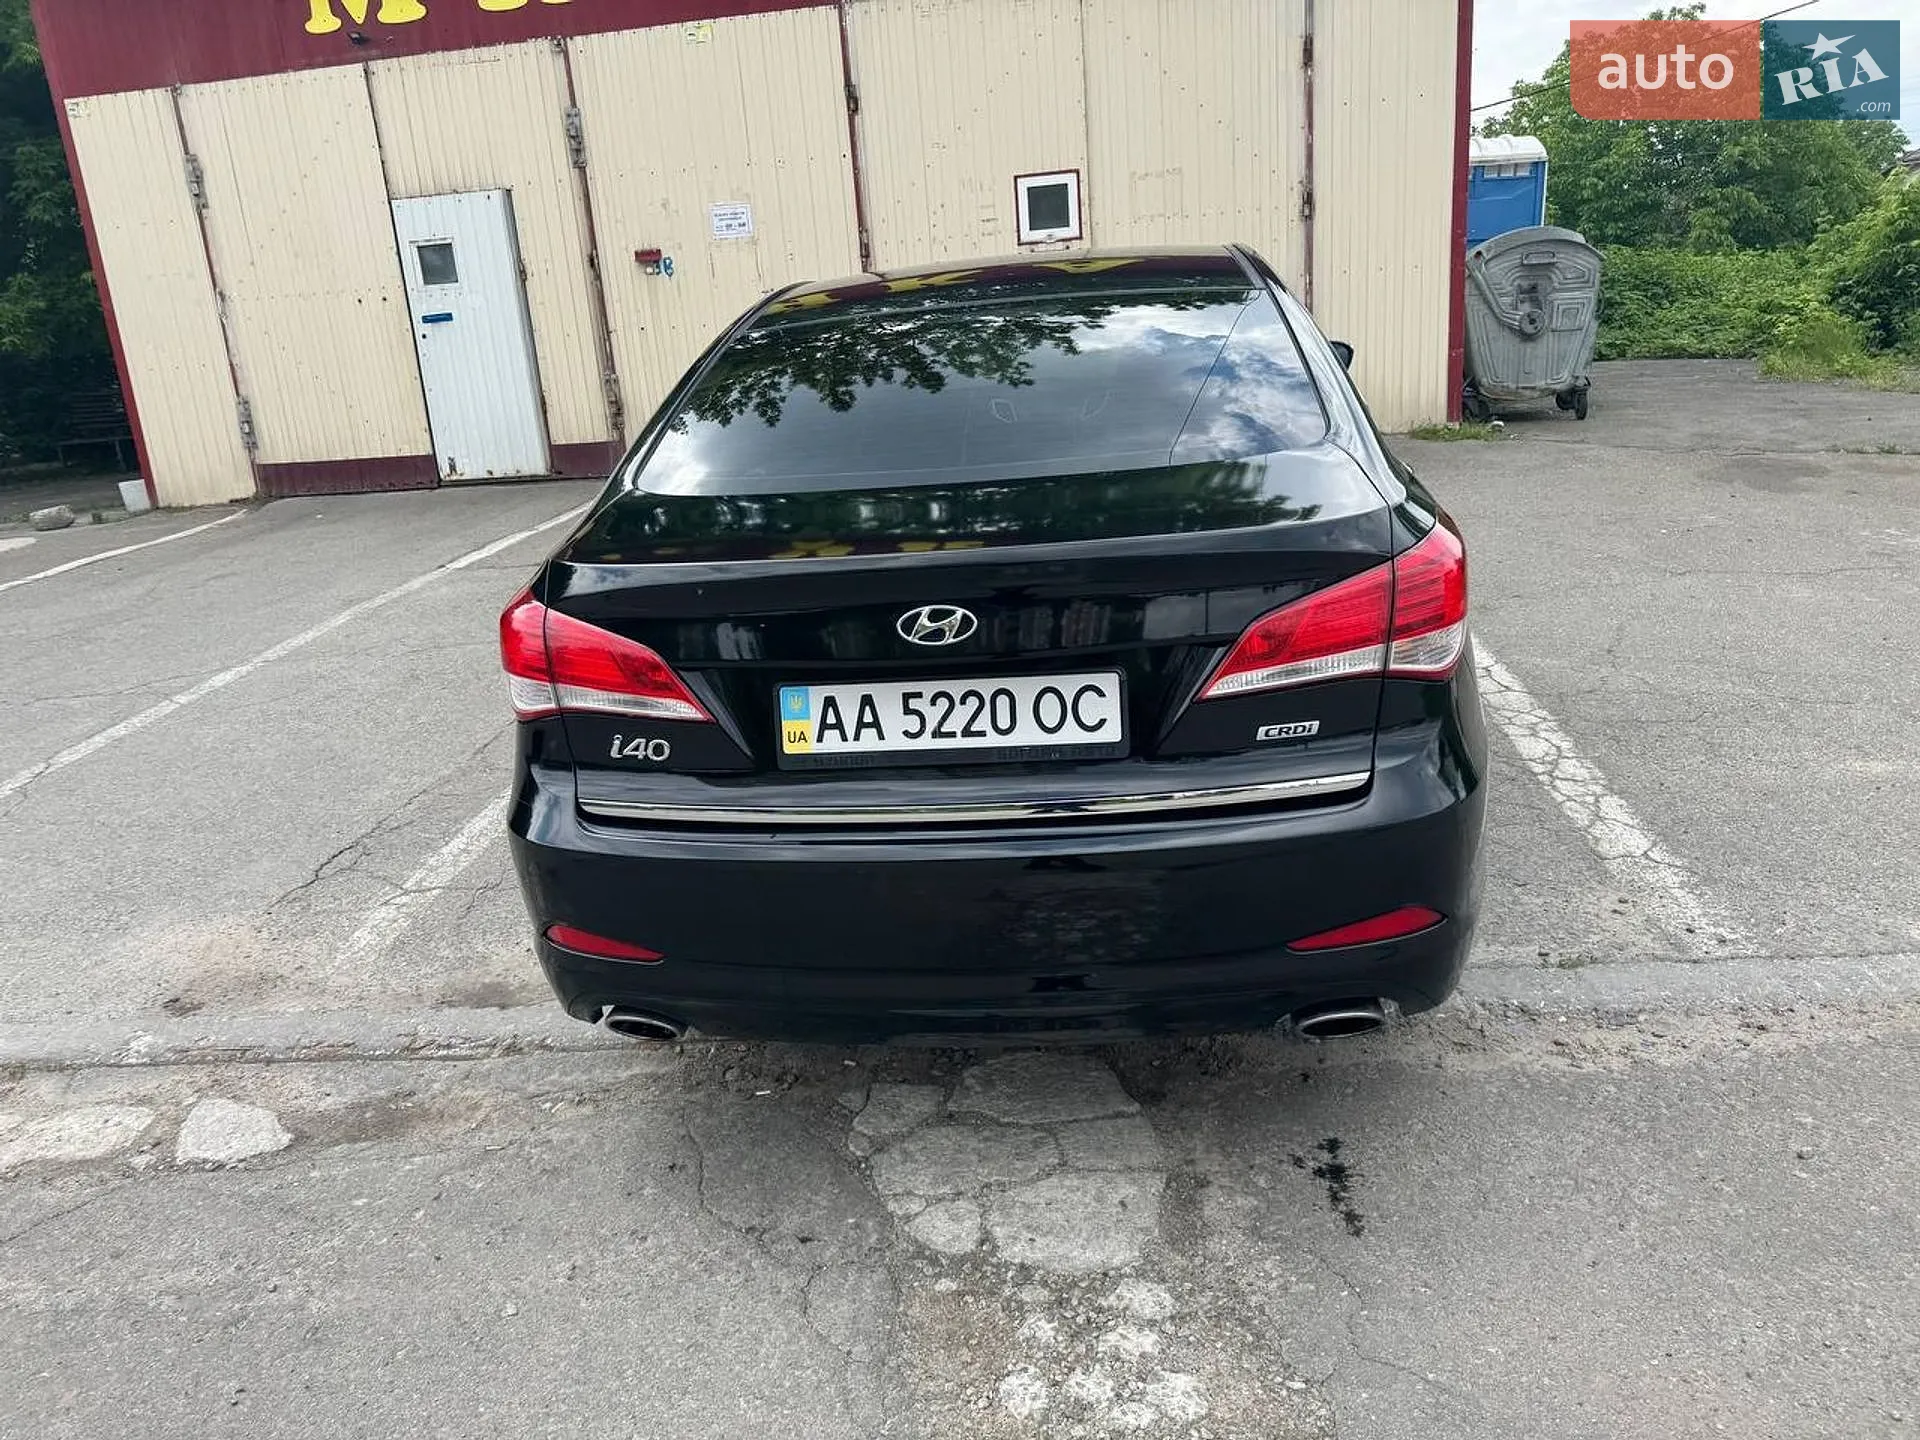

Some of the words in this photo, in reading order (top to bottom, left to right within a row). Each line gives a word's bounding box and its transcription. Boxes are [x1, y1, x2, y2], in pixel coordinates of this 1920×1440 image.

[816, 693, 886, 743] AA
[901, 687, 1017, 740] 5220
[1032, 684, 1108, 734] OC
[610, 734, 671, 760] i40
[787, 731, 808, 744] UA
